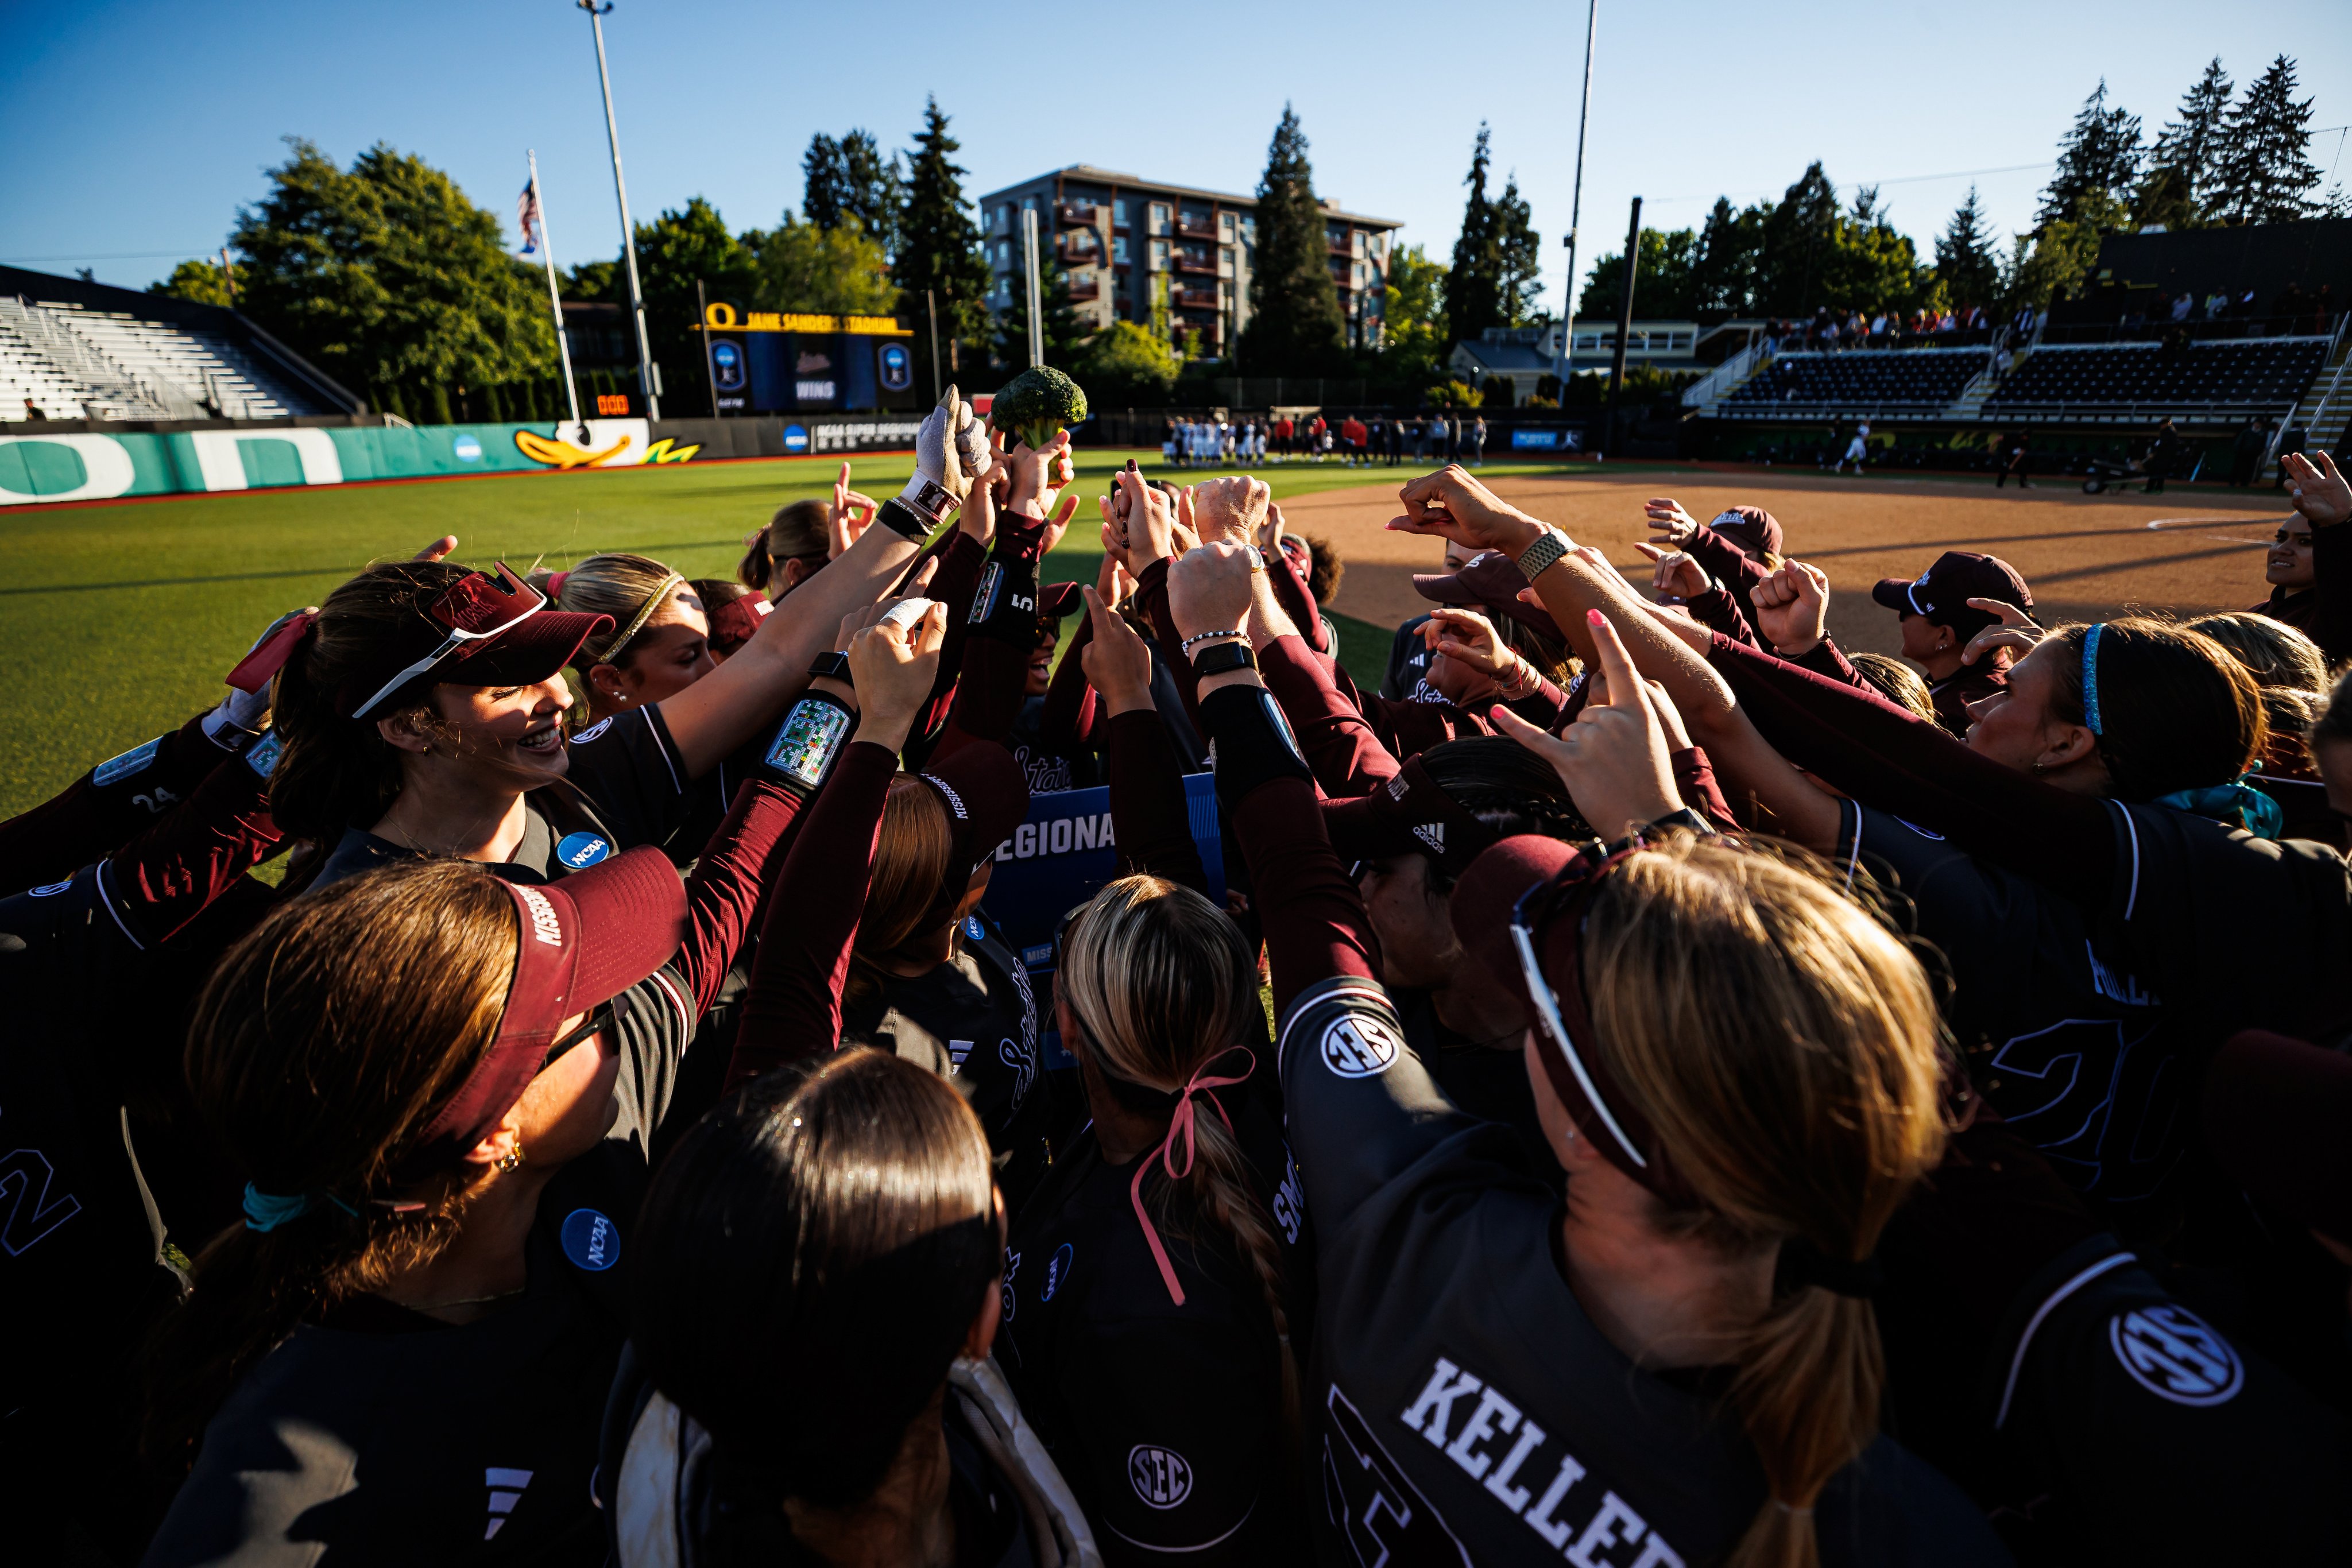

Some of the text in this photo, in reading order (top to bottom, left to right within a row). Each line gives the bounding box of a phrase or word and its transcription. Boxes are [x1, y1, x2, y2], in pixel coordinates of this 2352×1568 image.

[796, 381, 835, 400] WINS
[877, 423, 919, 435] REGIONA
[1012, 594, 1032, 611] 5
[133, 787, 181, 813] 24
[995, 812, 1115, 861] EGIONA
[1413, 826, 1445, 854] adidas
[571, 839, 606, 866] NCAA
[1328, 1018, 1394, 1072] SEC
[587, 1215, 609, 1266] NCAA
[2123, 1306, 2229, 1393] SEC
[1134, 1449, 1185, 1503] SEC
